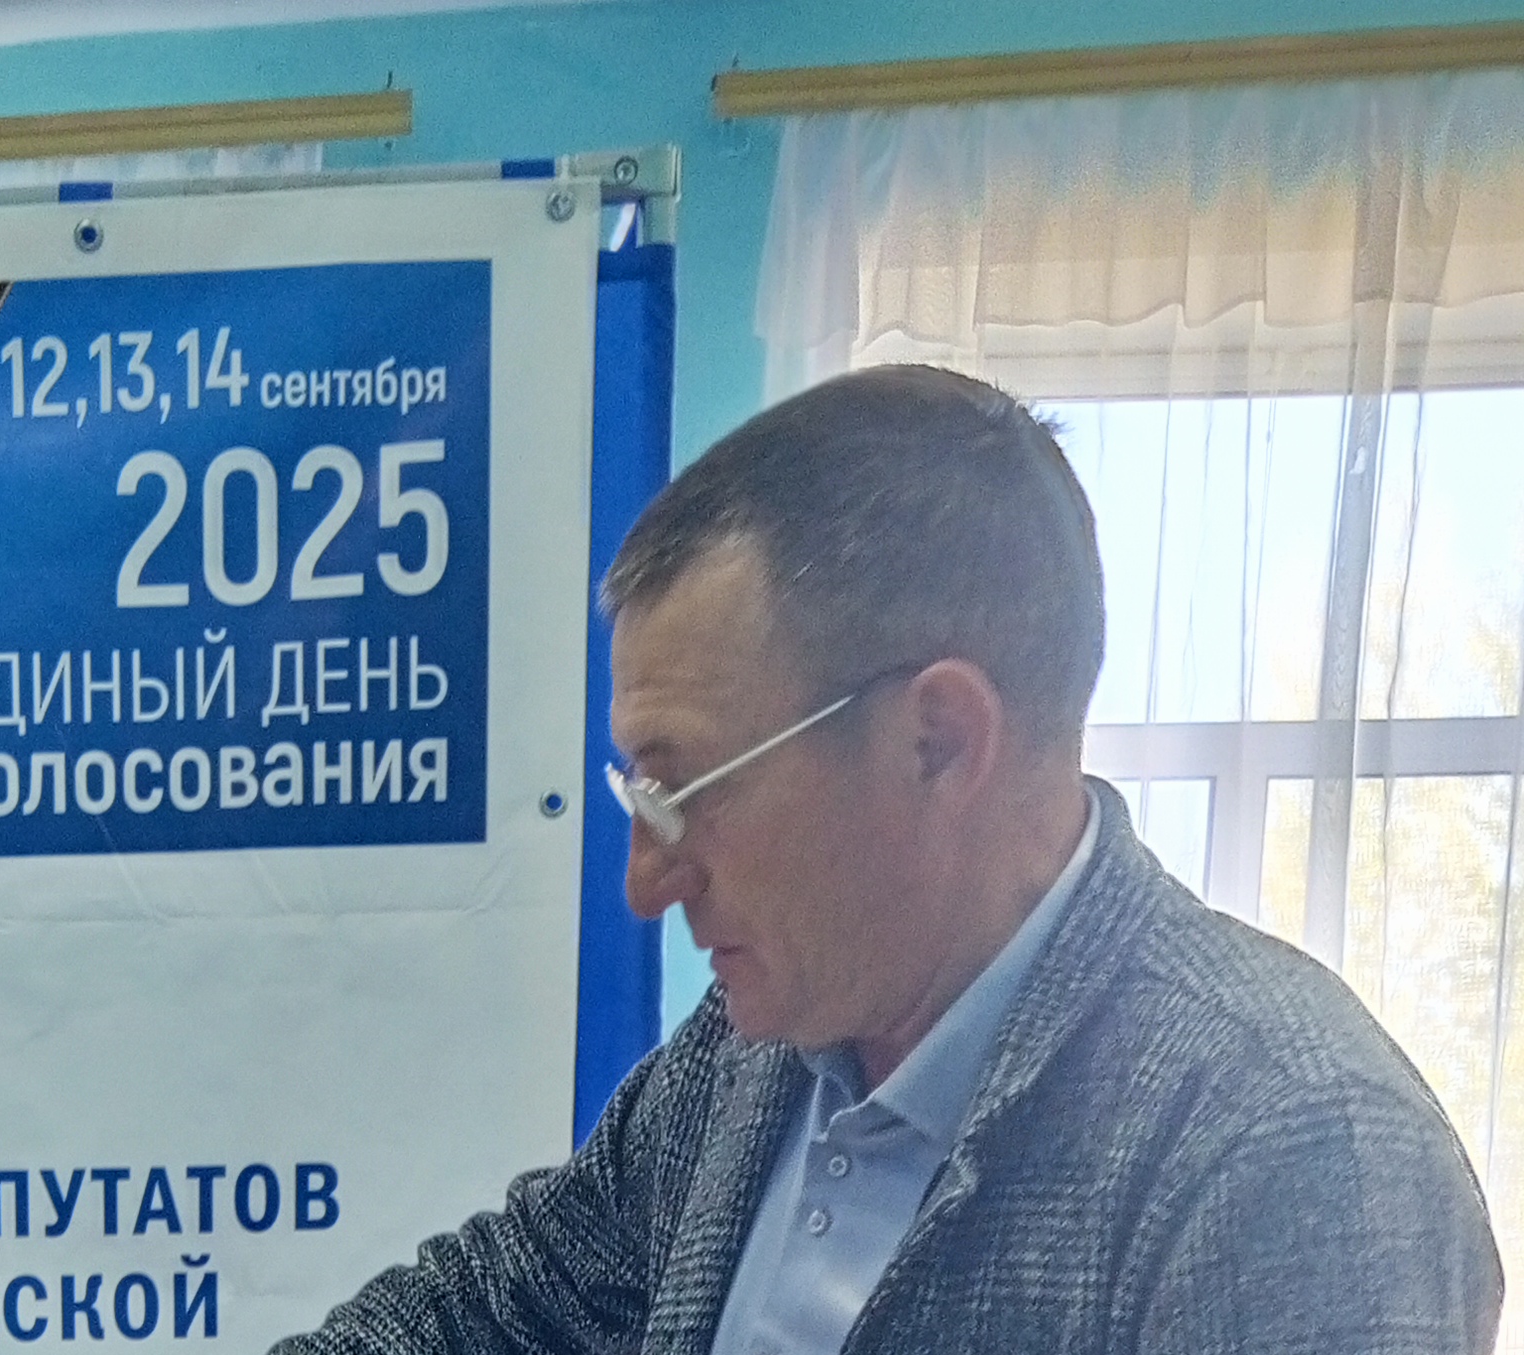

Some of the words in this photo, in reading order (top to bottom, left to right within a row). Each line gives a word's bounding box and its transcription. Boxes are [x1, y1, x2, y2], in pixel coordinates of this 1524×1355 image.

[1, 326, 249, 428] 12,13,14
[260, 357, 446, 414] сентября
[116, 439, 449, 608] 2025
[261, 635, 448, 727] ДЕНЬ
